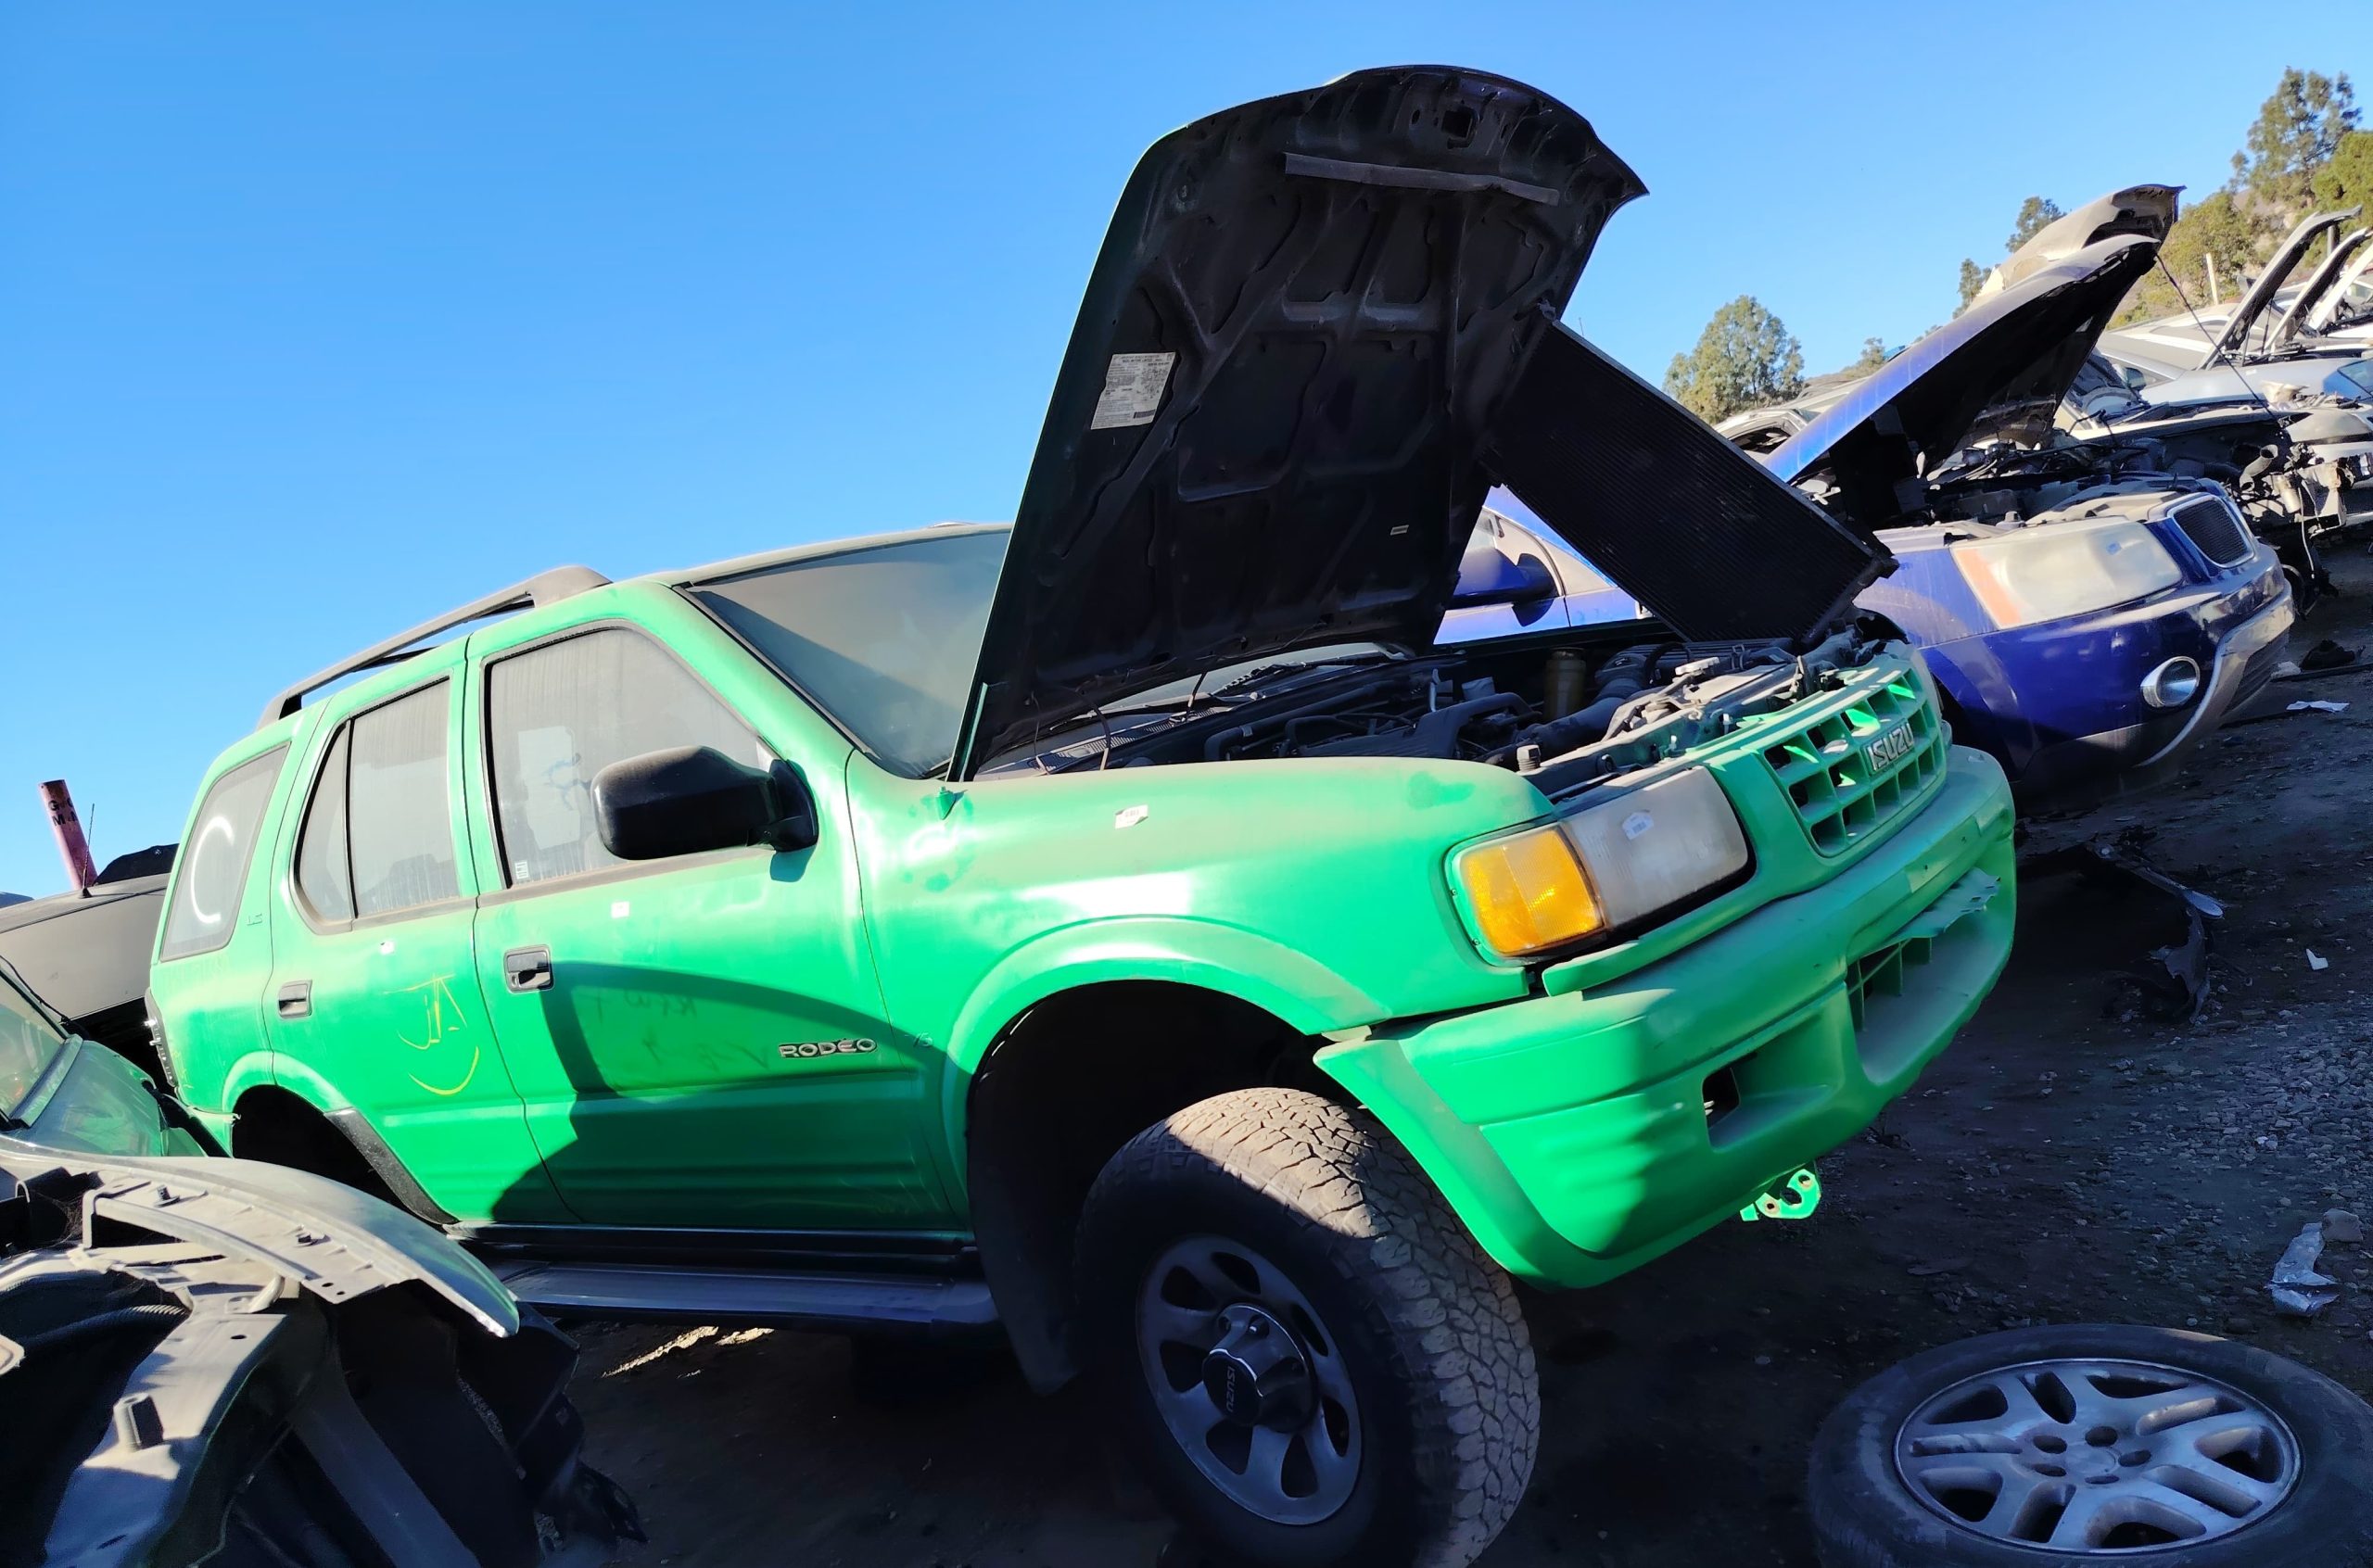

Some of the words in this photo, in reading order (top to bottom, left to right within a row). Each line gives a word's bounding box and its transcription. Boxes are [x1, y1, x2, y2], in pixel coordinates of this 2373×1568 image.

[1867, 722, 1914, 771] ISUZU
[779, 1038, 877, 1057] RODEO
[1225, 1365, 1237, 1413] ISUZU
